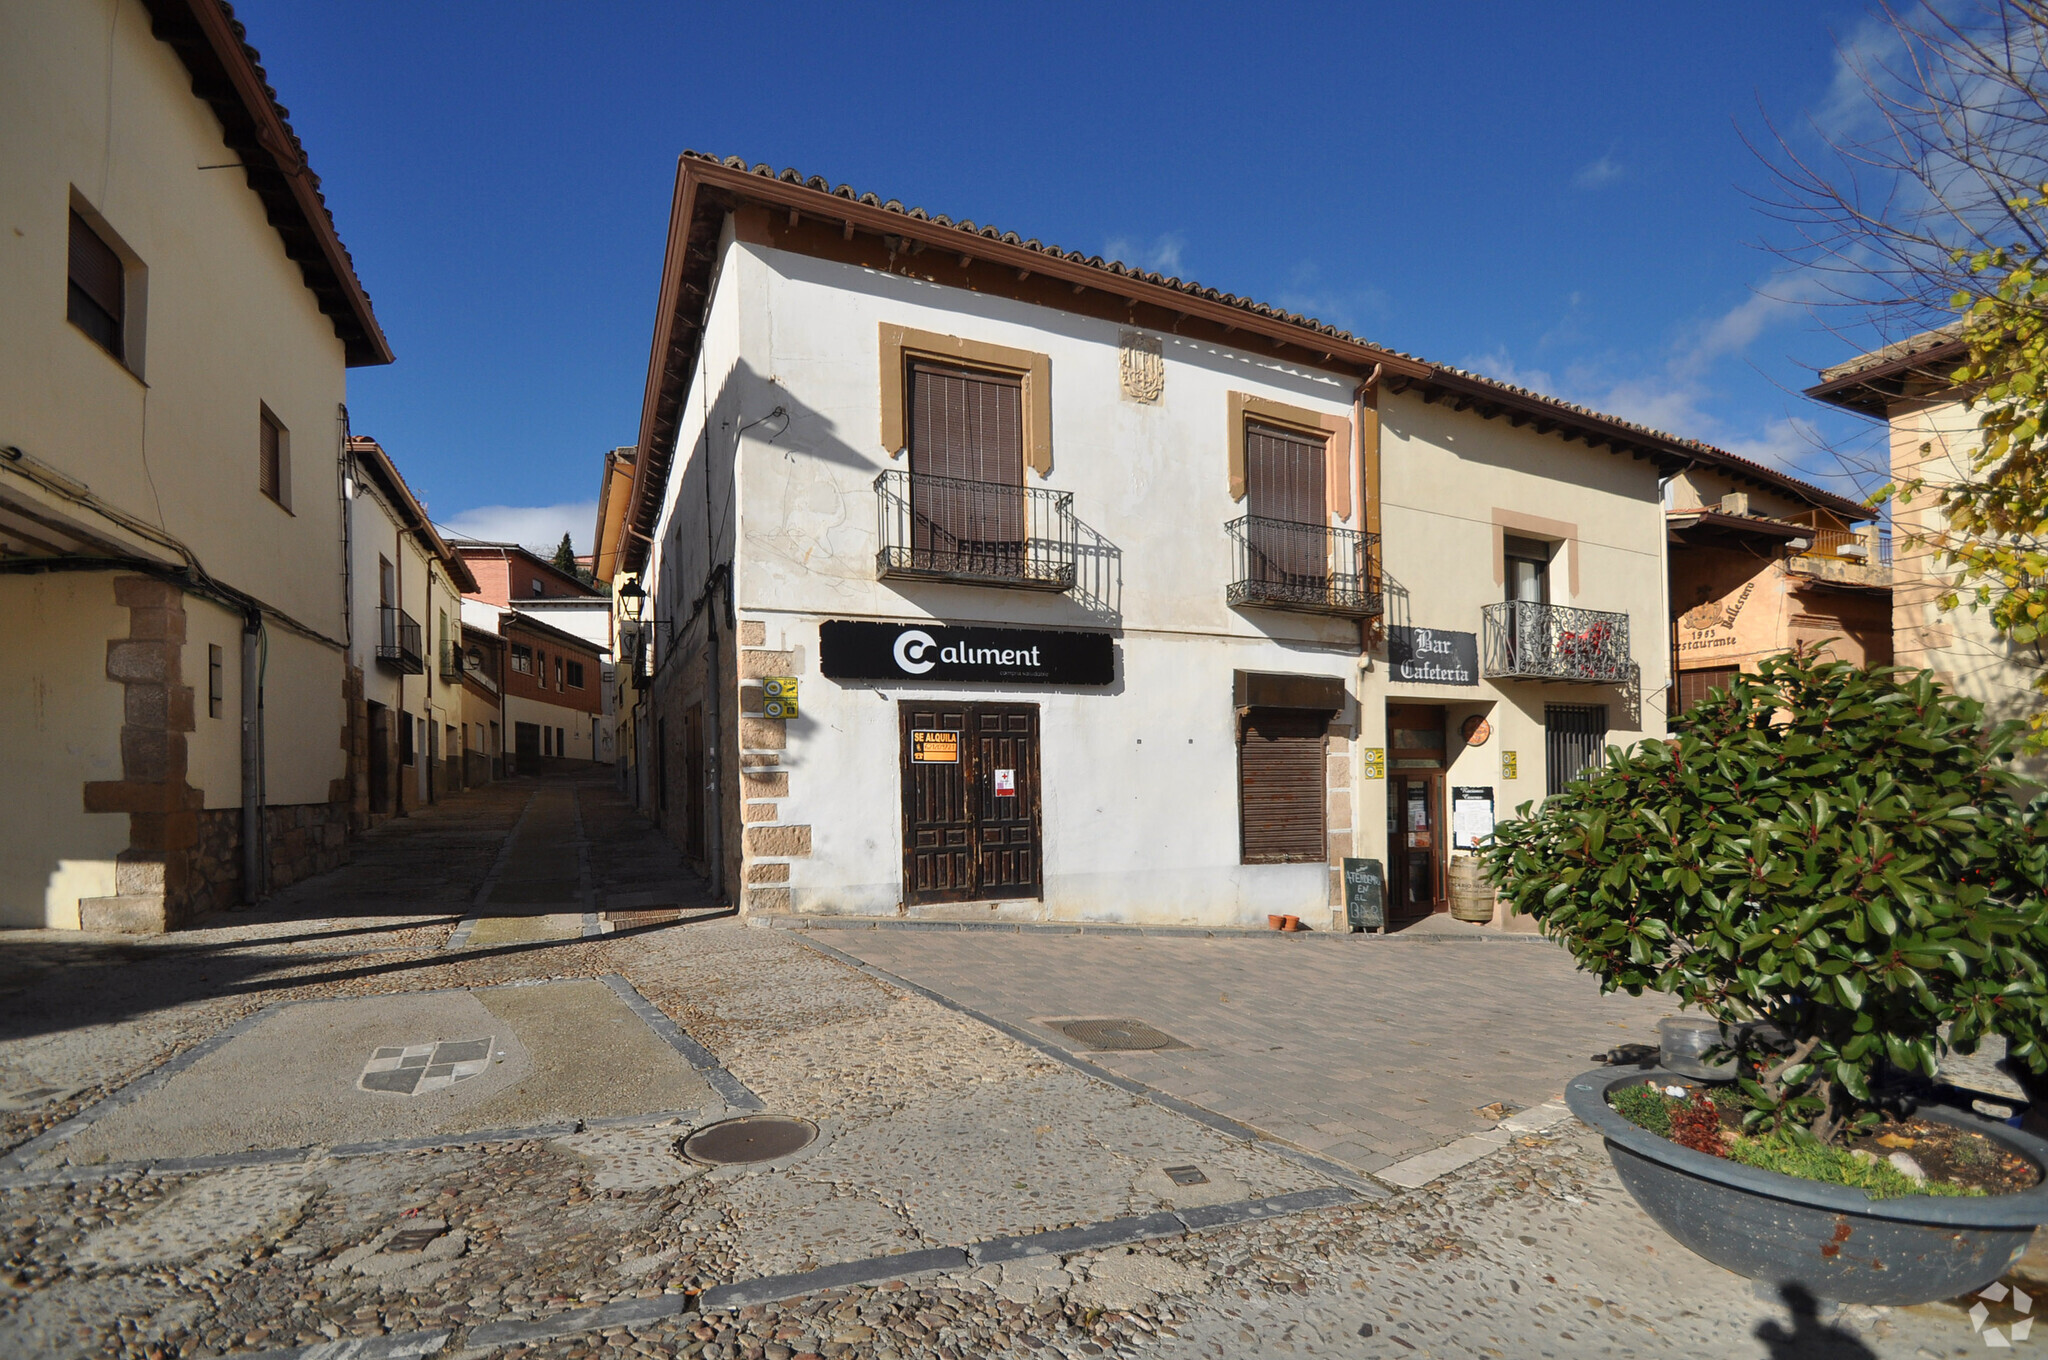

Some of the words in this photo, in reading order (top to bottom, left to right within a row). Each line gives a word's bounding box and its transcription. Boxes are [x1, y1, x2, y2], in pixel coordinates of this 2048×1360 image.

[1721, 582, 1755, 630] Ballestero
[1414, 628, 1452, 660] Bar
[1400, 660, 1469, 683] Cafetería
[914, 732, 925, 742] SE
[925, 733, 957, 743] ALQUILA
[1357, 884, 1369, 894] EN
[1350, 901, 1381, 921] BAR
